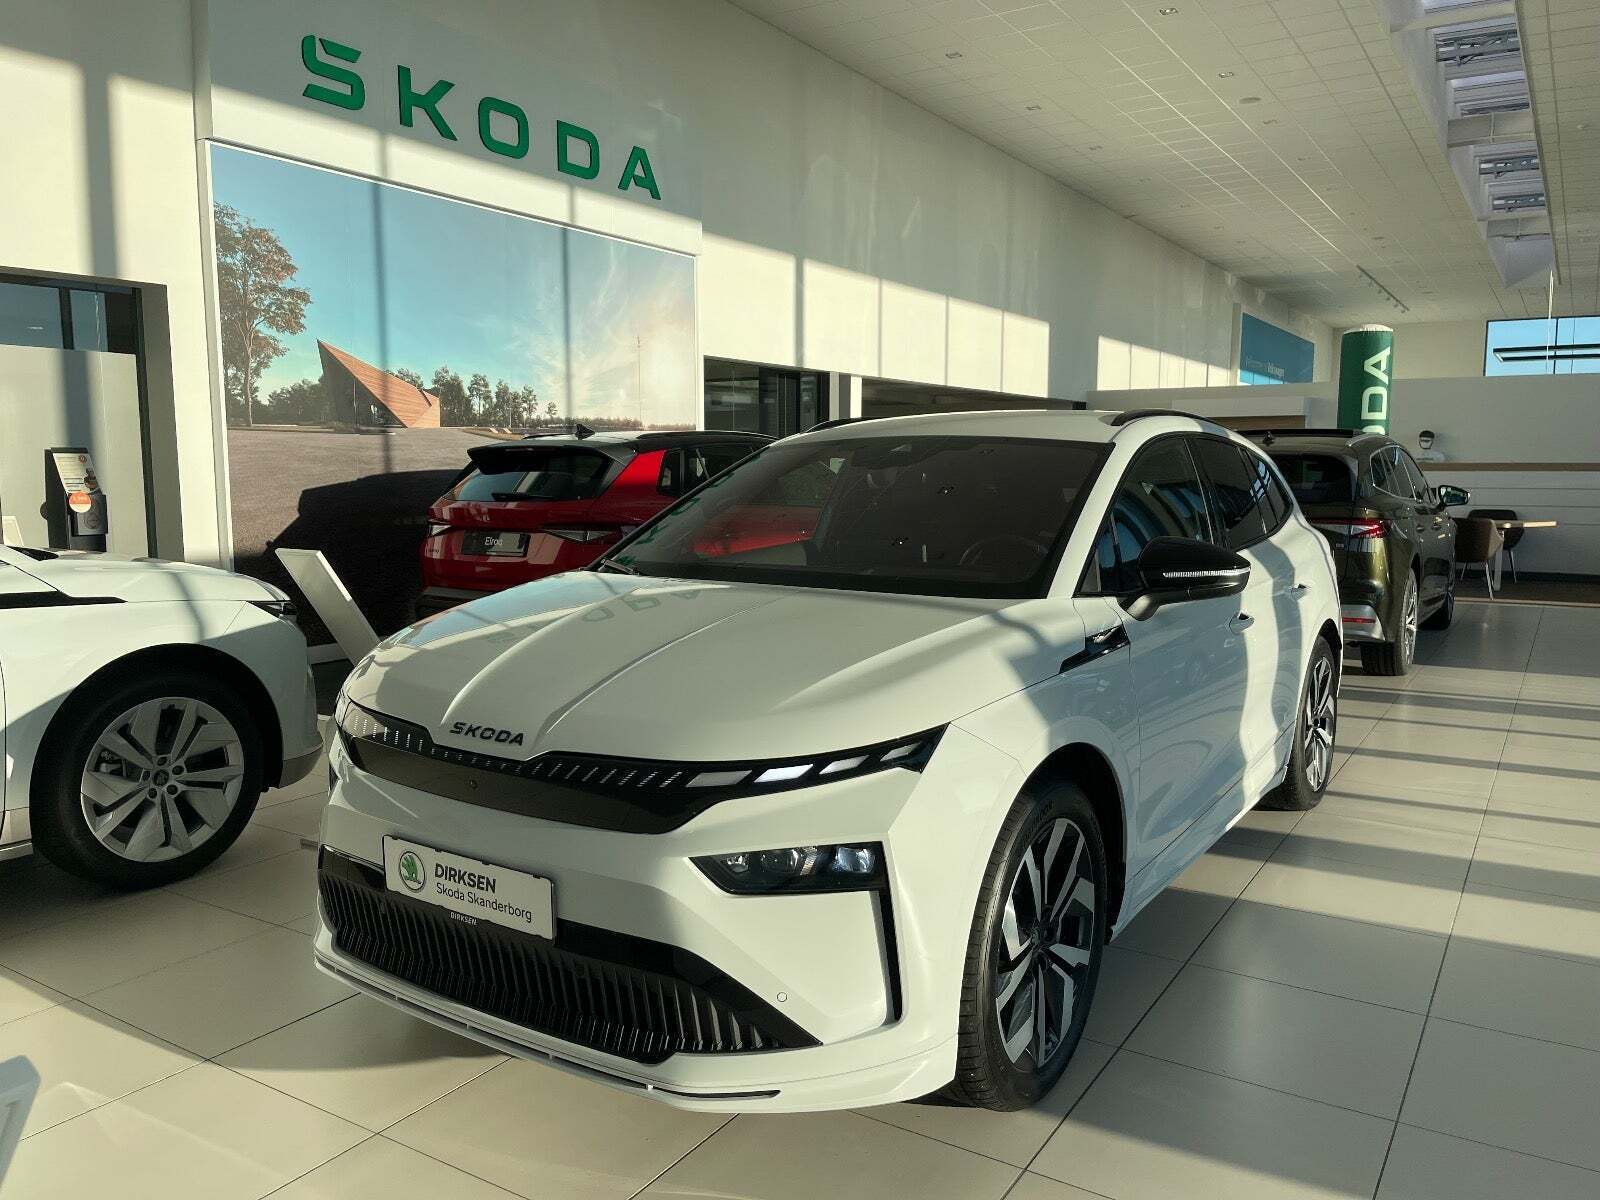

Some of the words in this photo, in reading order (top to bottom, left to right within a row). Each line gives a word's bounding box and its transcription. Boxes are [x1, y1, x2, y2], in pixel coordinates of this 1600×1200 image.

[301, 35, 661, 200] SKODA
[450, 721, 524, 746] SKODA
[434, 863, 497, 894] DIRKSEN
[436, 882, 465, 901] Skoda
[467, 891, 532, 923] Skanderborg
[450, 911, 478, 926] DIRKSEN
